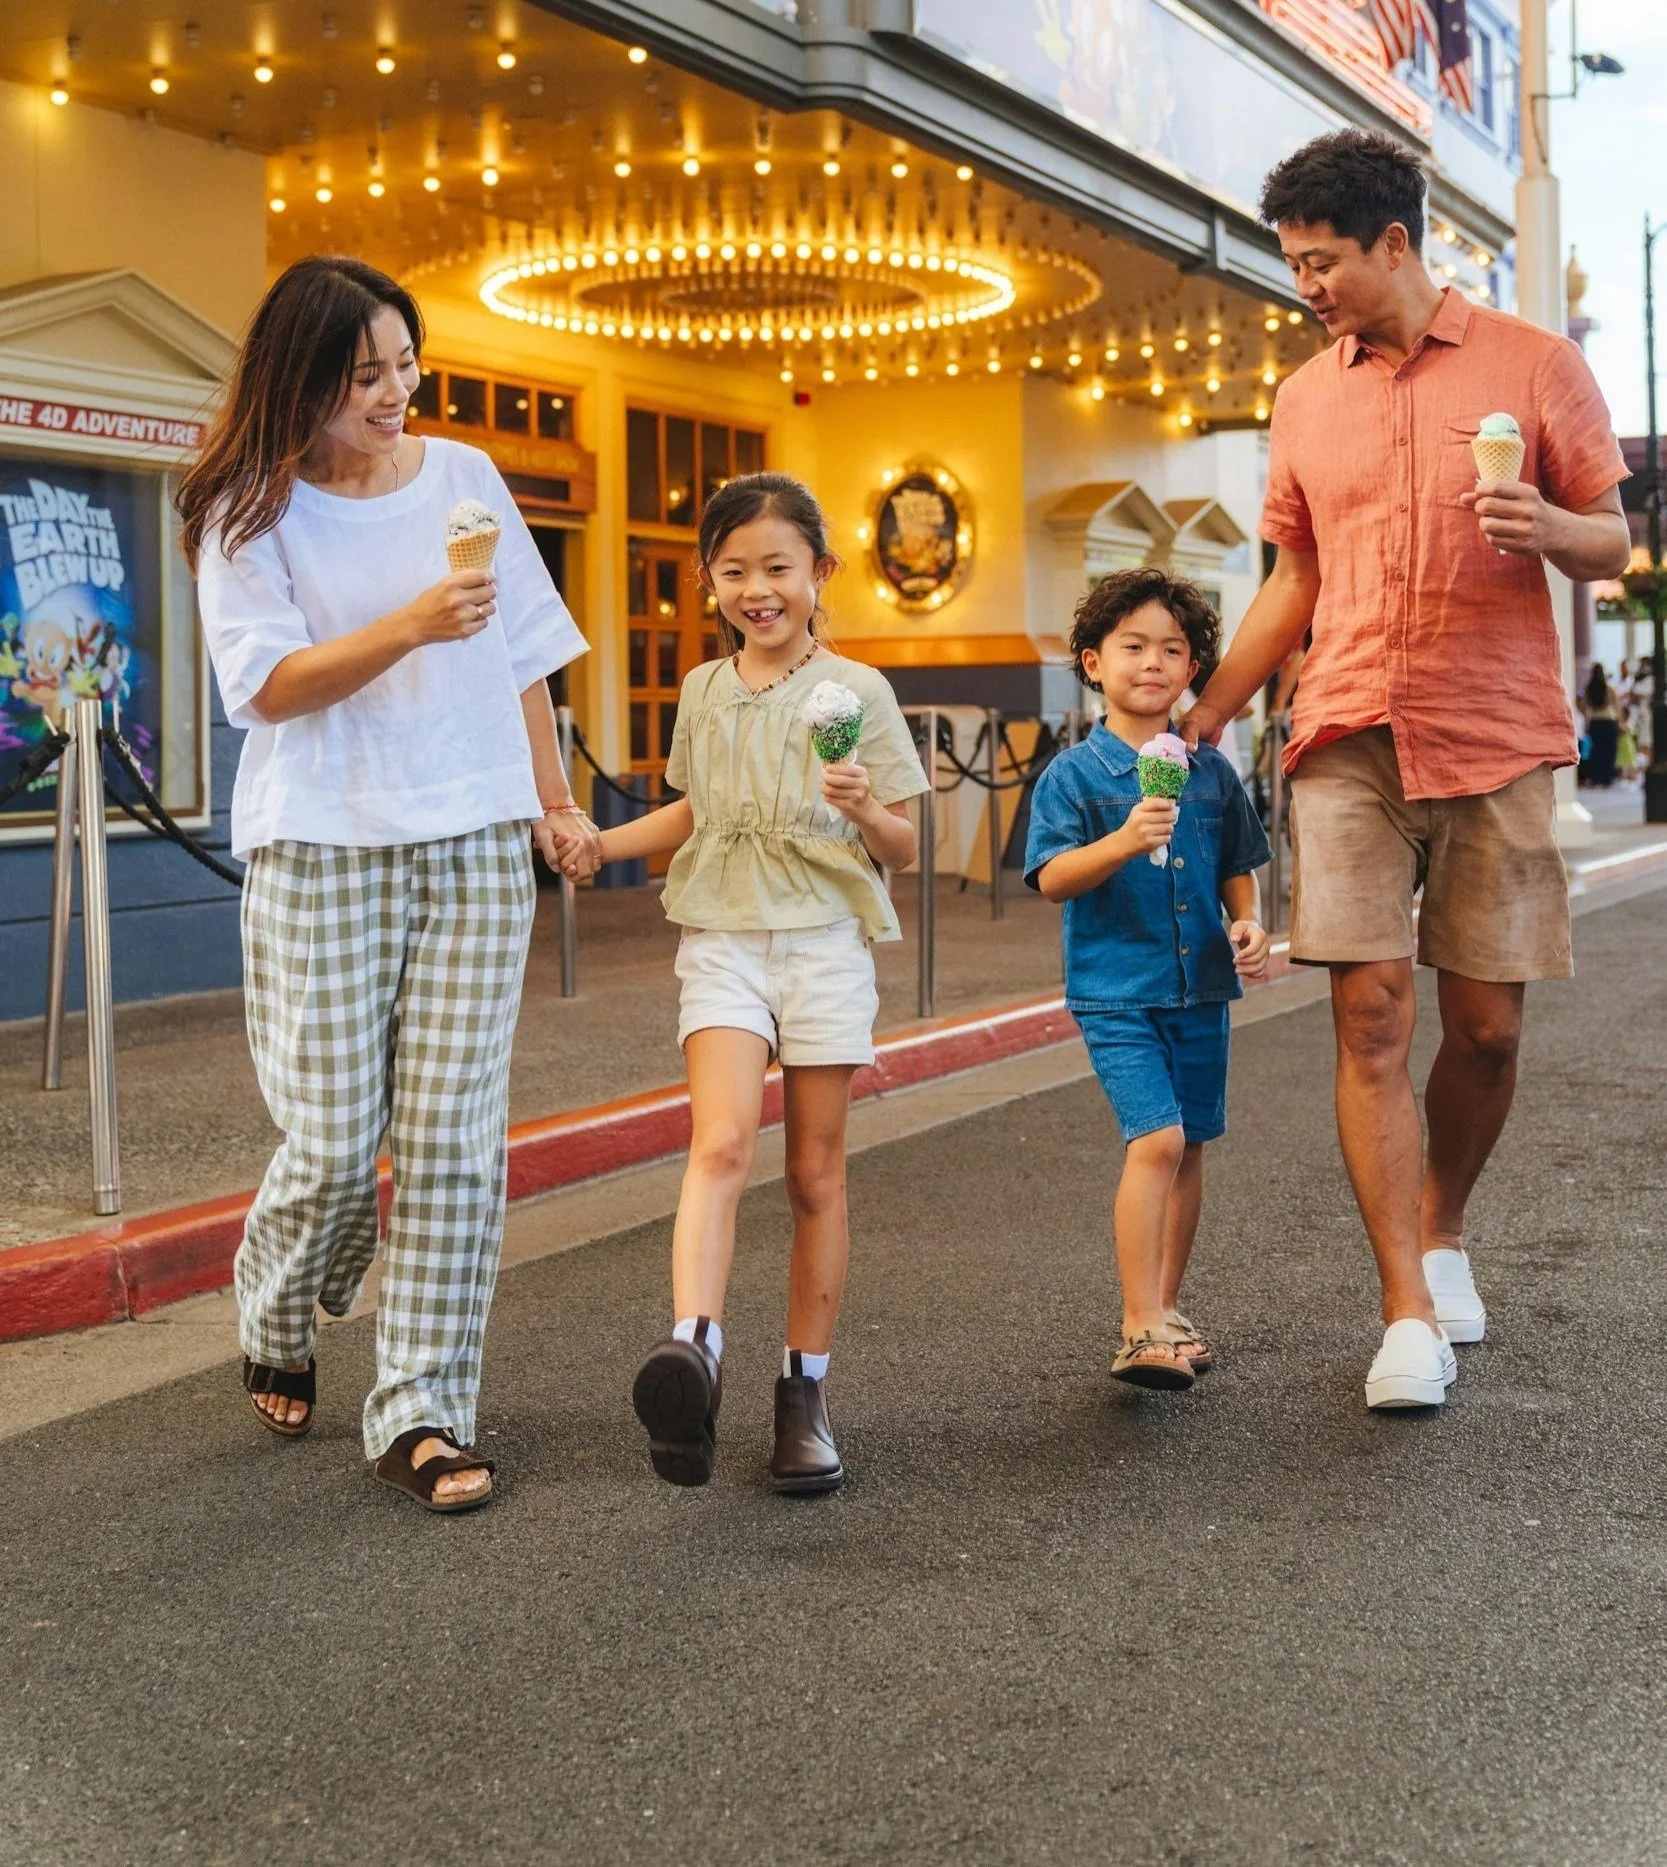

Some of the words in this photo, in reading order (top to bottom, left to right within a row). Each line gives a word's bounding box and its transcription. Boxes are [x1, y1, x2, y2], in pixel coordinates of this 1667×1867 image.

[0, 399, 34, 425] HE
[37, 406, 68, 428] 4D
[71, 410, 200, 447] ADVENTURE
[0, 494, 40, 526] THE
[28, 478, 89, 525] DAY
[9, 521, 121, 564] EARTH
[14, 553, 89, 611] BLEW
[88, 557, 125, 592] UP
